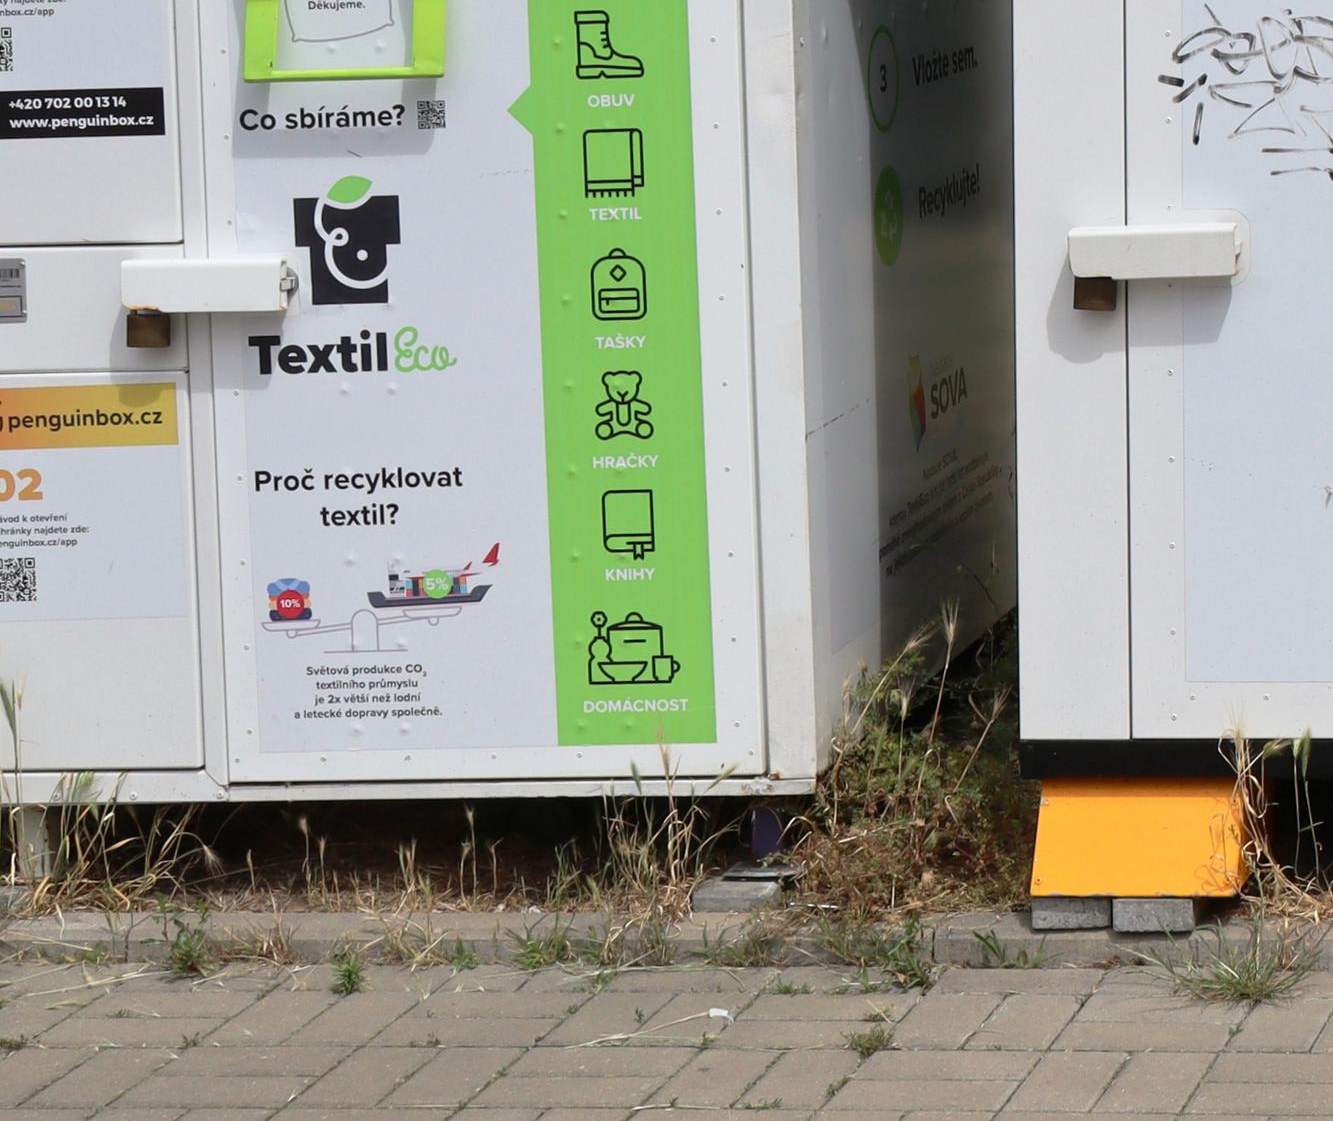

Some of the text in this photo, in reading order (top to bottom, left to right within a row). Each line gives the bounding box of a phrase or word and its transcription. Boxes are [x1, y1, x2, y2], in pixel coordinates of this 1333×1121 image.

[879, 45, 979, 91] 3 Vložte sem.
[587, 93, 635, 108] OBUV
[9, 114, 154, 129] www.penguinbox.cz
[239, 104, 405, 131] Co sbíráme?
[918, 170, 981, 218] Recyklujte!
[589, 207, 643, 221] TEXTIL
[594, 332, 646, 349] TAŠKY
[930, 367, 968, 420] SOVA
[8, 408, 163, 433] penguinbox.cz
[592, 453, 659, 470] HRAČKY
[254, 466, 463, 495] Proč recyklovat
[320, 503, 399, 526] textil?
[604, 567, 655, 581] KNIHY
[425, 577, 449, 591] 5%
[280, 599, 301, 609] 10%
[583, 696, 688, 714] DOMÁCNOST
